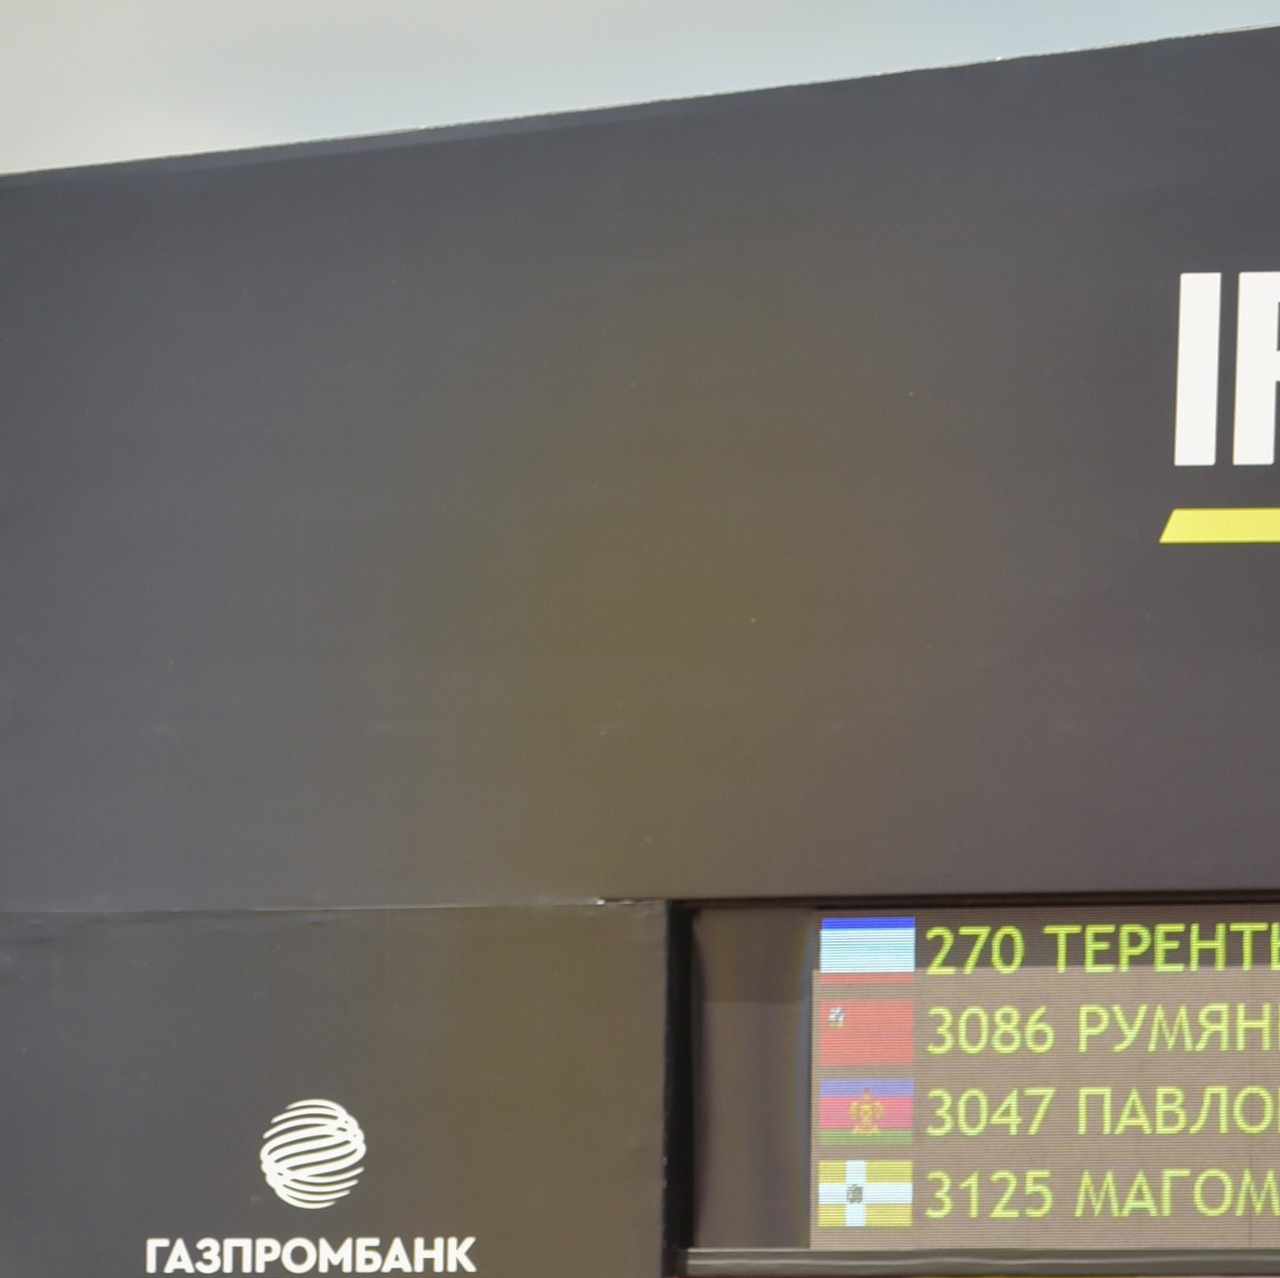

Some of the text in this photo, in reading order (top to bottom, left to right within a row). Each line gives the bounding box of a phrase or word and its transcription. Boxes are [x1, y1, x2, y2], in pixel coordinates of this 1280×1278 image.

[925, 926, 1025, 975] 270
[926, 1005, 1055, 1055] 3086
[926, 1086, 1055, 1137] 3047
[925, 1170, 1053, 1219] 3125
[146, 1237, 477, 1274] ГАЗПРОМБАНК
